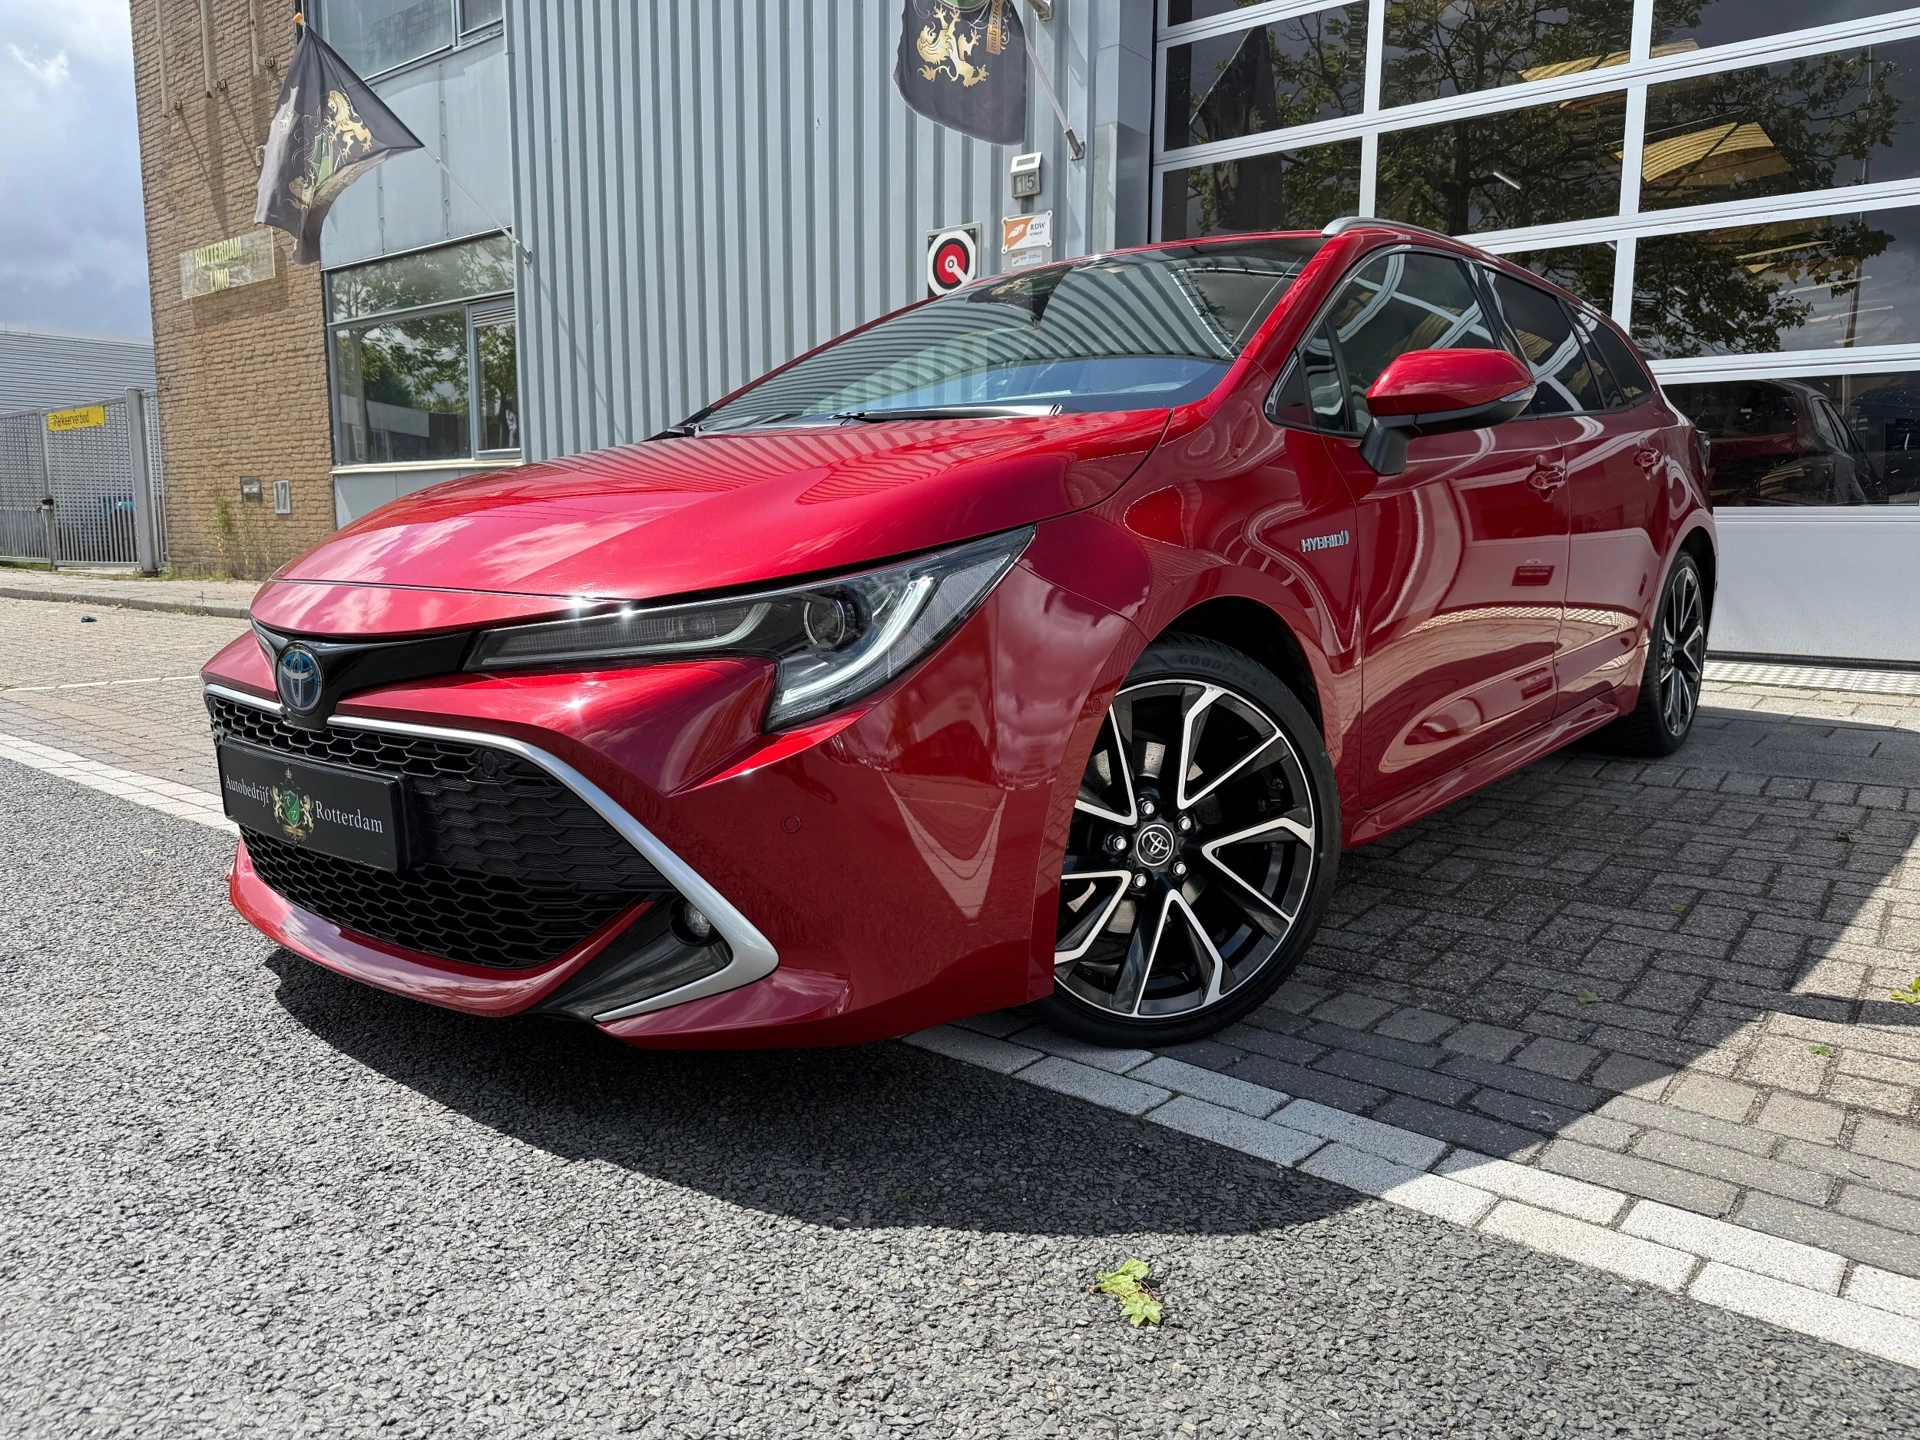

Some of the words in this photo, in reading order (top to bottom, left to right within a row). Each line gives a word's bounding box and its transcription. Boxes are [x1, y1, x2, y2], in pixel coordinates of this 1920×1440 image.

[1018, 174, 1035, 192] 15
[1030, 222, 1046, 230] RDW
[195, 236, 242, 269] ROTTERDAM
[210, 267, 230, 292] LIMO
[53, 410, 90, 427] Parkeerverbod
[274, 482, 288, 510] 17
[1301, 530, 1349, 552] HYBRID
[226, 774, 269, 807] Autobedrijf
[315, 800, 383, 833] Rotterdam
